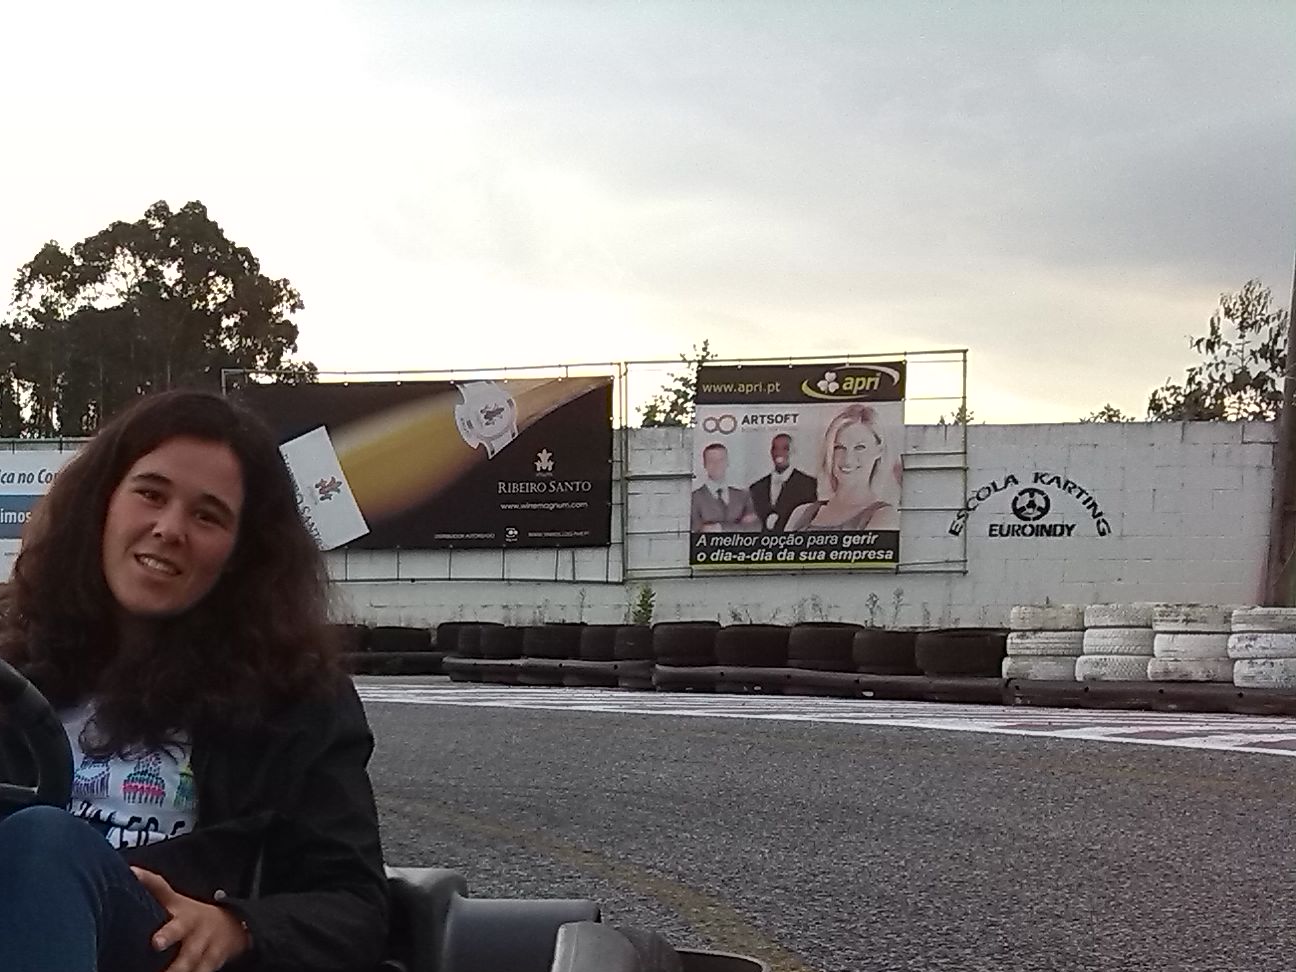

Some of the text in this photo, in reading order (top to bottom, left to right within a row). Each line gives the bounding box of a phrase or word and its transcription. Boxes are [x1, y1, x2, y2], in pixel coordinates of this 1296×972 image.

[702, 382, 781, 394] www.apri.pt
[842, 373, 882, 395] apri
[741, 413, 799, 426] ARTSOFT
[17, 472, 34, 484] no
[498, 480, 592, 493] RIBEIRO SANTO
[948, 472, 1111, 537] ESCOLA KARTING
[989, 523, 1076, 537] EUROINDY
[696, 533, 879, 548] A melhor opção para gerir
[697, 549, 894, 563] o dia-a-dia da sua empresa
